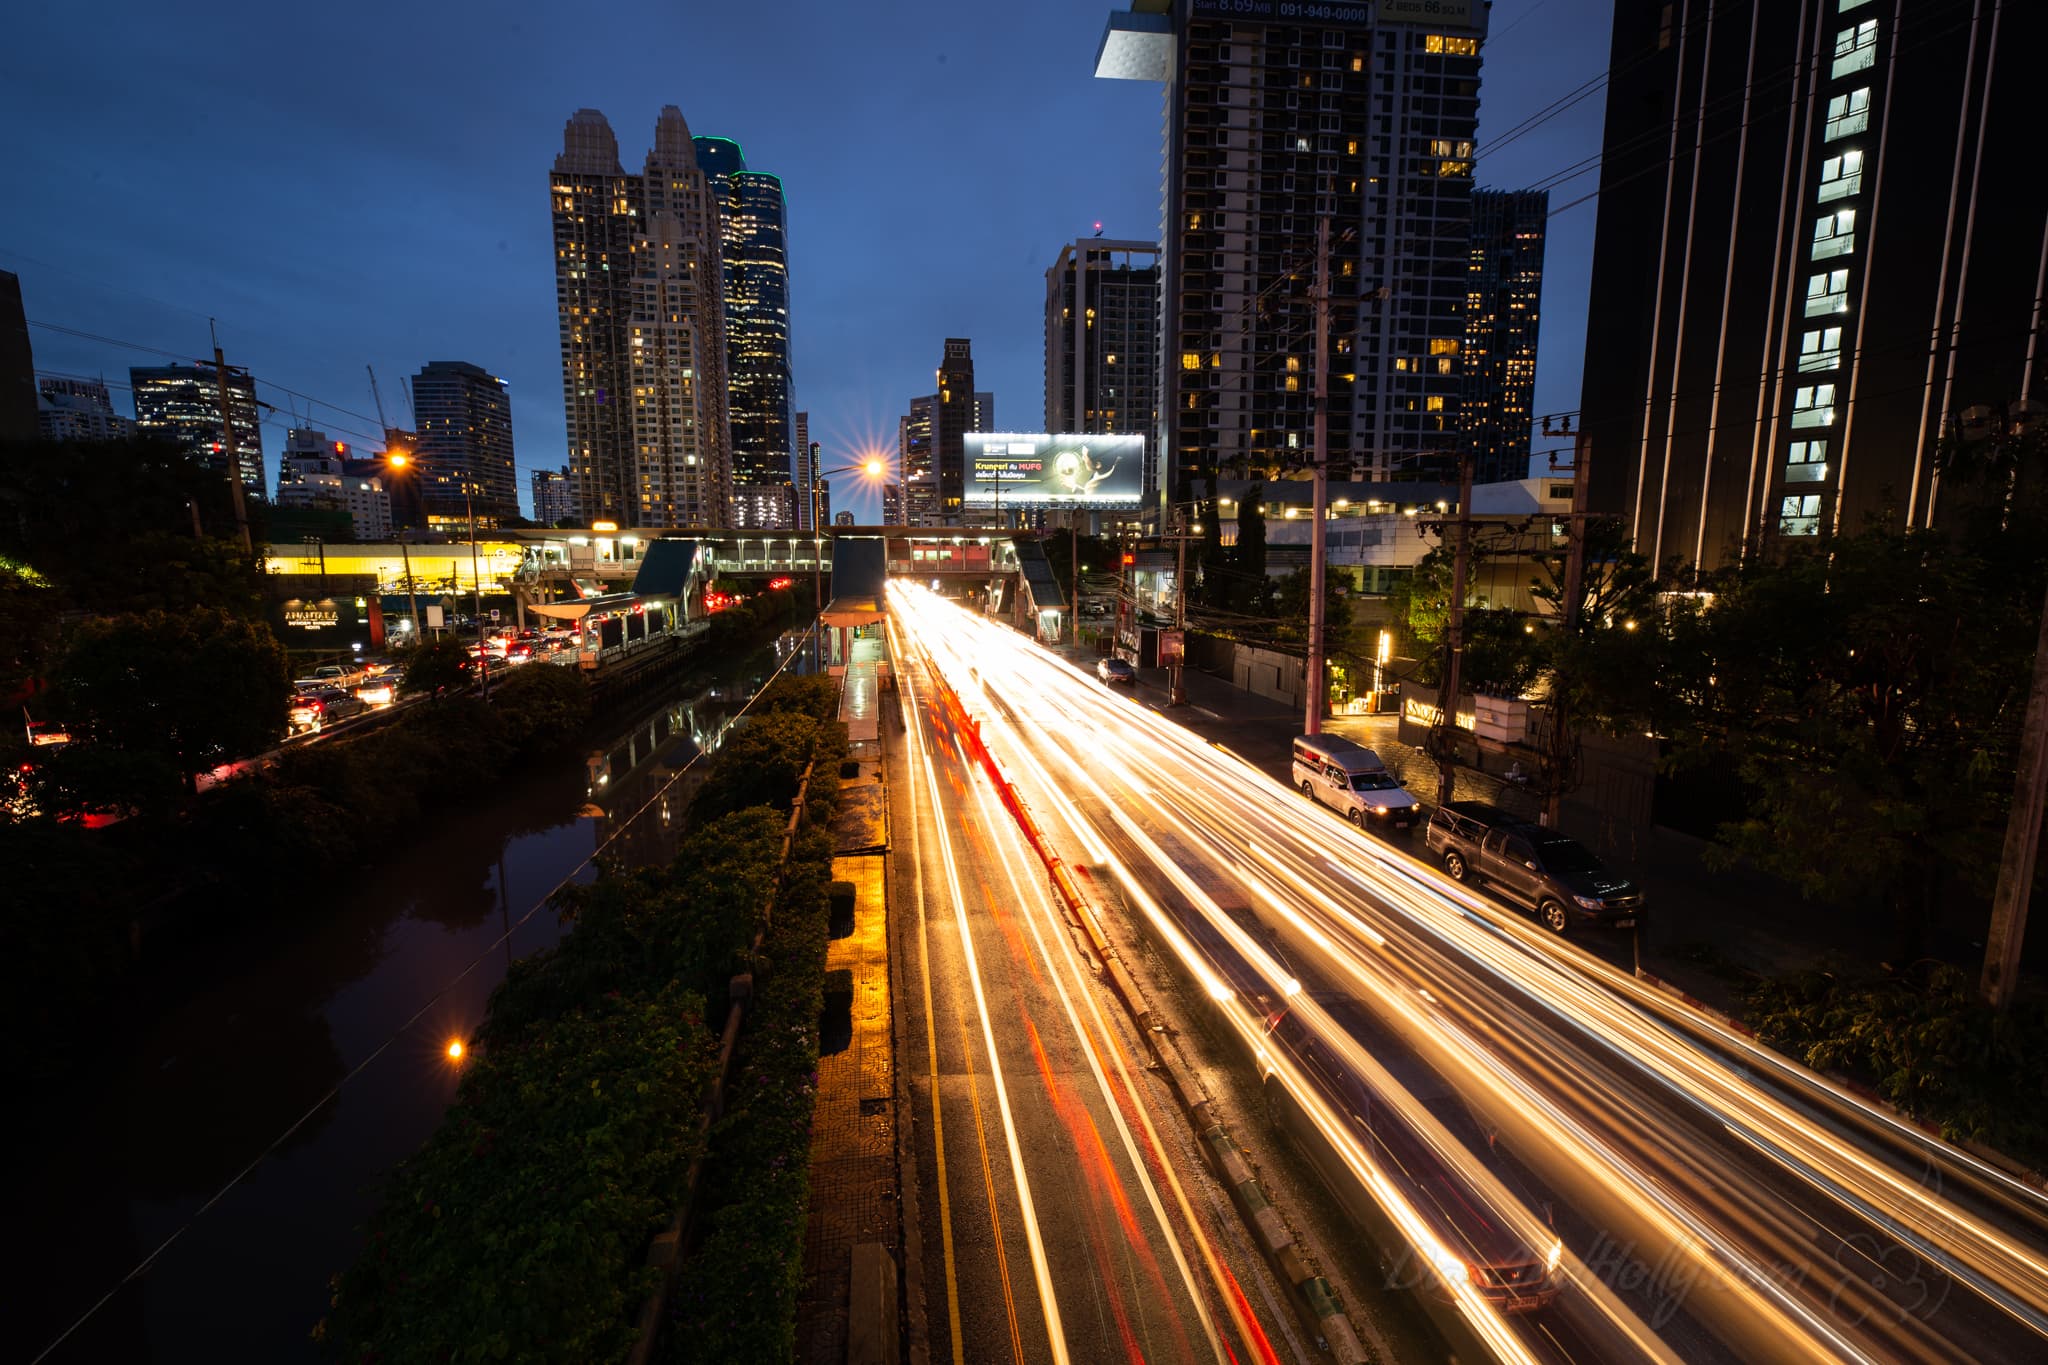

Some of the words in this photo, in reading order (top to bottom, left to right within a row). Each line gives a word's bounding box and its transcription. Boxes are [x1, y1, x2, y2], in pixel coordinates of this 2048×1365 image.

[1385, 0, 1393, 10] 2
[1280, 3, 1366, 21] 091-949-0000
[1018, 463, 1042, 471] MUFG
